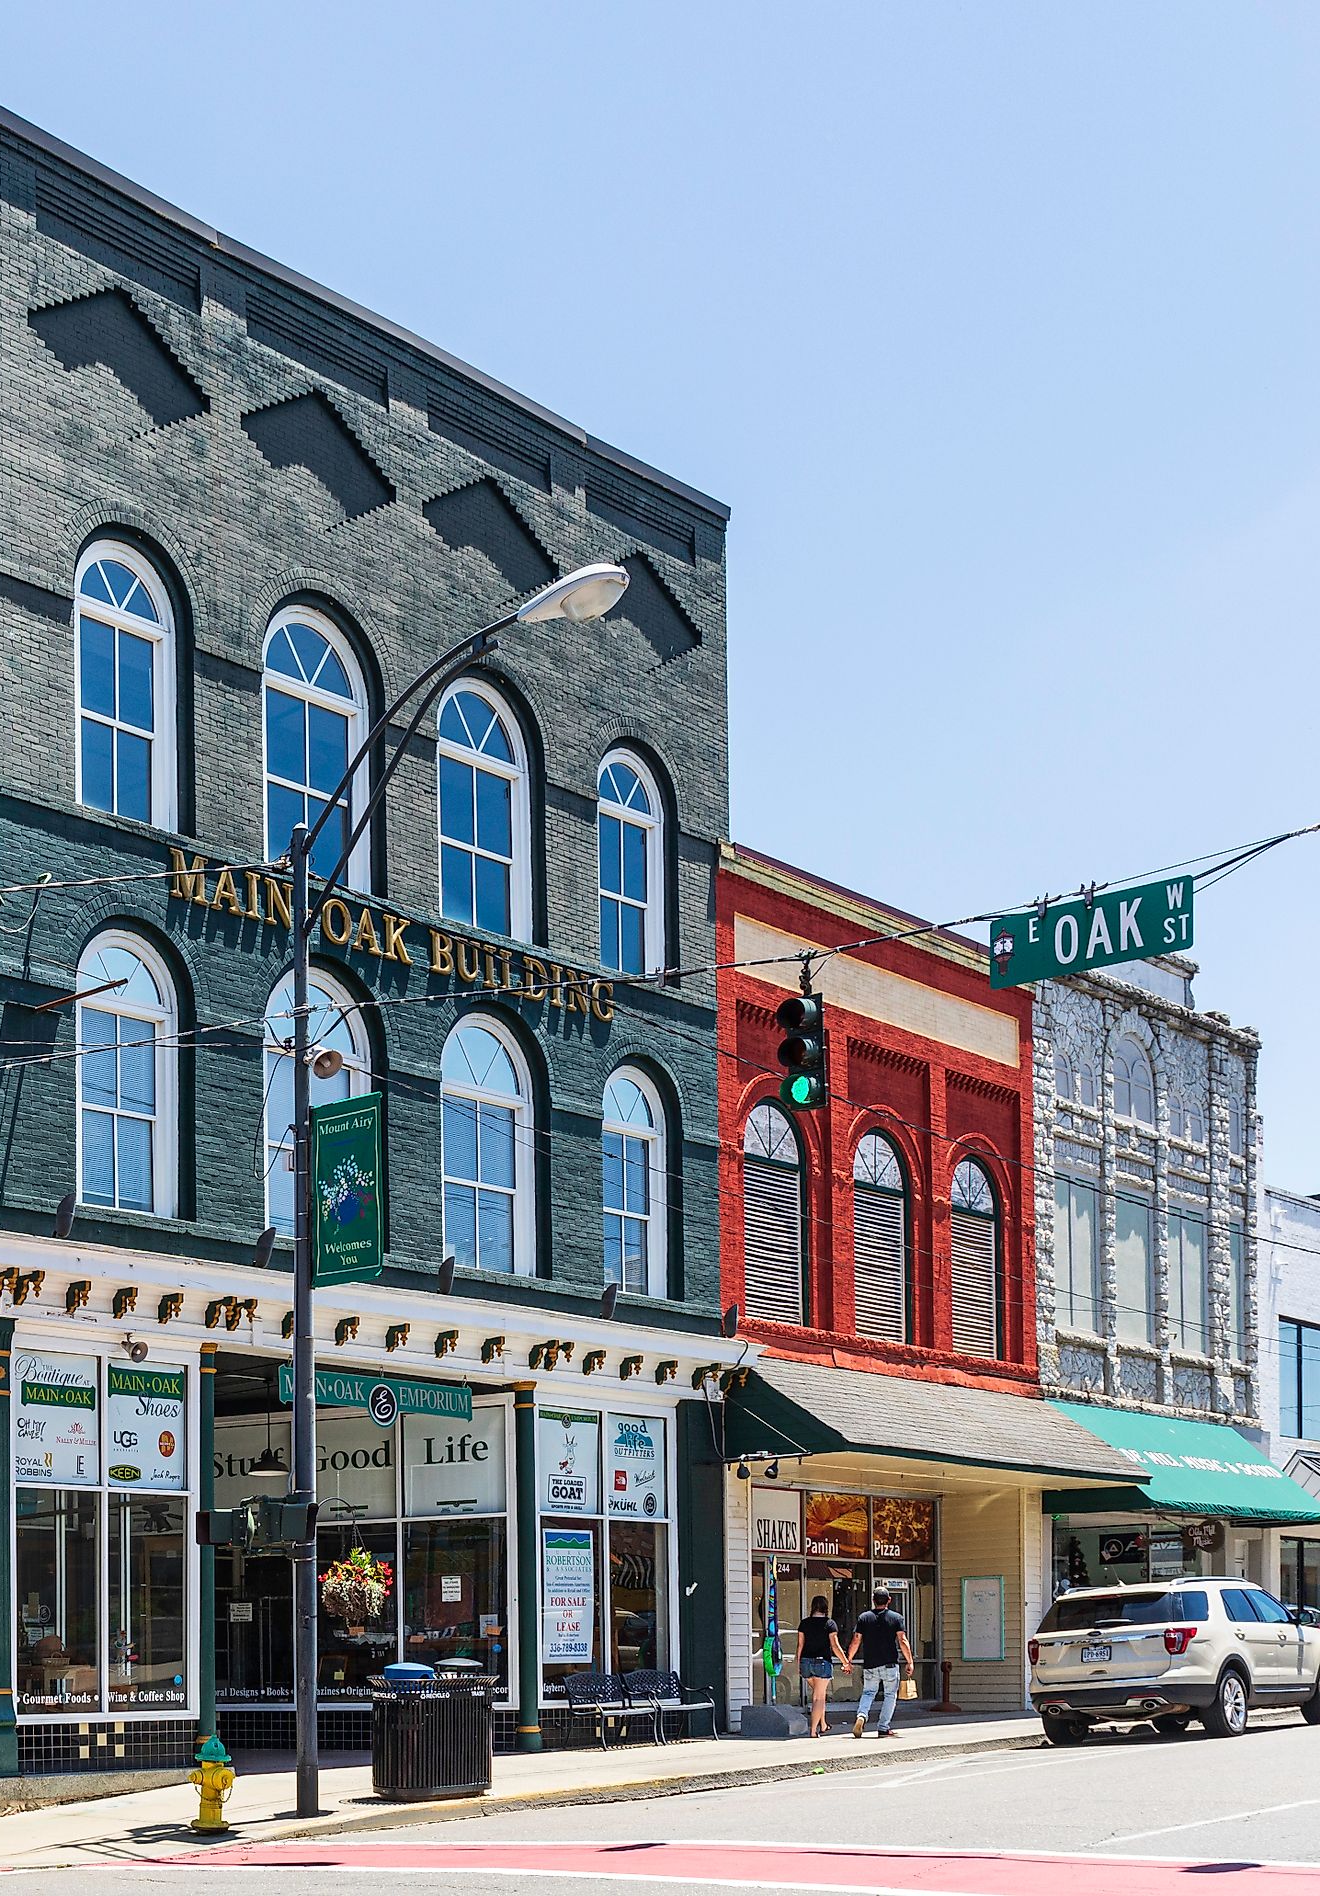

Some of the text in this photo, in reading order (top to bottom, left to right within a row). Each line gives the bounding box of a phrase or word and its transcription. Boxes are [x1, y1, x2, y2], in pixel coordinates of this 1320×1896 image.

[1029, 882, 1184, 965] E OAK W
[1164, 913, 1189, 944] ST
[170, 847, 615, 1022] MAIN OAK BUILDING
[320, 1116, 373, 1136] Mount Airy
[325, 1238, 372, 1255] Welcomes
[340, 1254, 357, 1266] You
[15, 1355, 83, 1389] Boutique
[285, 1375, 468, 1413] MN OAK EMPORIUM
[136, 1391, 180, 1418] Shoes
[17, 1418, 42, 1431] OH MY
[618, 1420, 647, 1434] good
[114, 1431, 138, 1448] UGG
[626, 1435, 644, 1451] life
[423, 1434, 489, 1464] Life
[615, 1448, 654, 1458] OUTFITTERS
[16, 1456, 43, 1466] ROYAL
[1180, 1455, 1228, 1473] MUSIC
[16, 1468, 52, 1477] ROBBINS
[110, 1468, 140, 1479] KEEN
[552, 1486, 583, 1499] GOAT
[614, 1499, 637, 1511] KÜHL
[757, 1519, 796, 1550] SHAKES
[1203, 1525, 1216, 1536] Mill
[806, 1538, 839, 1555] Panini
[874, 1541, 901, 1556] Pizza
[1193, 1537, 1213, 1547] Music
[546, 1556, 591, 1565] ROBERTSON
[778, 1564, 790, 1573] 244
[550, 1597, 586, 1606] FOR SALE
[563, 1610, 573, 1618] OR
[557, 1622, 580, 1631] LEASE
[23, 1690, 185, 1705] Gourmet Foods Wine & Coffee Shop
[230, 1687, 258, 1698] Designs
[266, 1687, 289, 1696] Books
[346, 1686, 373, 1698] Origin
